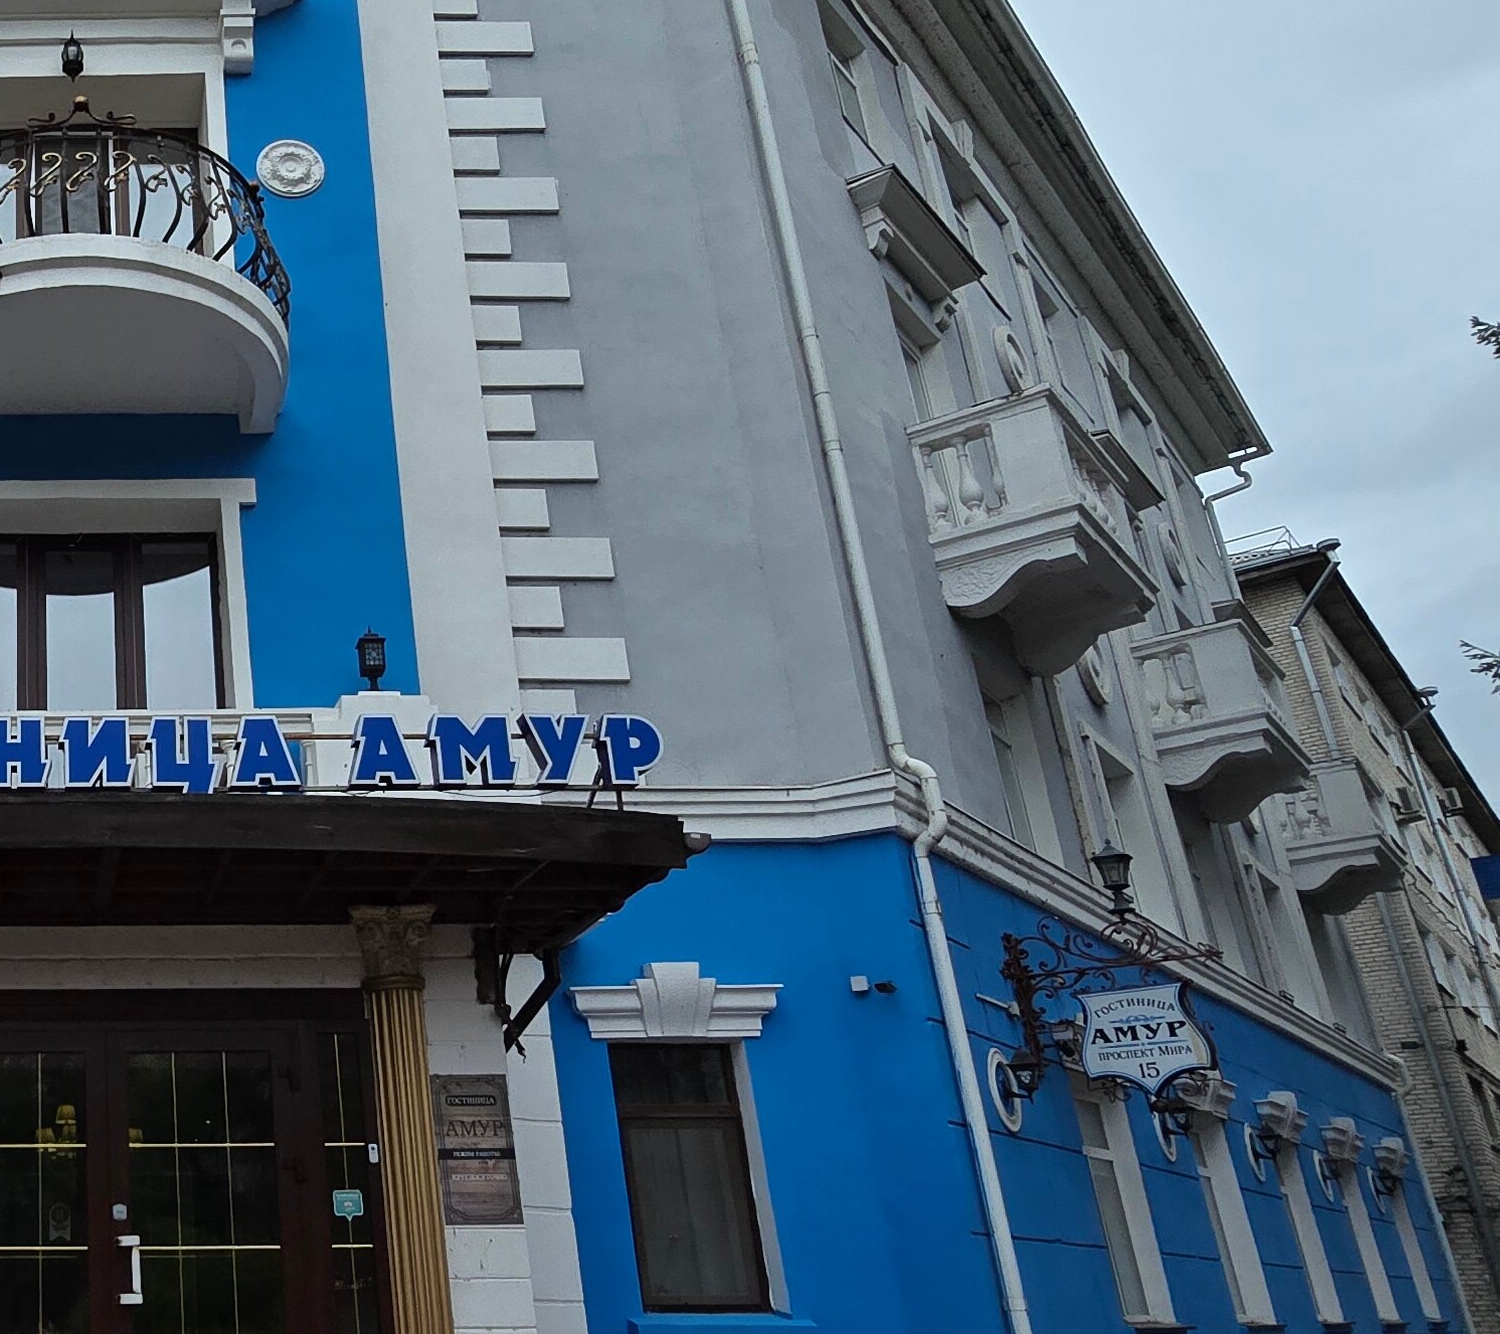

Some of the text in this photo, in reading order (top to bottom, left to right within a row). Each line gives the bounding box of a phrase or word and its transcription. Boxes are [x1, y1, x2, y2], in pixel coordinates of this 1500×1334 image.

[349, 713, 664, 789] АМУР
[1094, 998, 1175, 1018] ГОСТИНИЦА
[1090, 1020, 1187, 1045] АМУР
[1098, 1048, 1155, 1061] ПРОСПЕКТ
[1138, 1061, 1161, 1079] 15
[447, 1096, 495, 1105] ГОСТИНИЦА
[445, 1119, 503, 1136] АМУР
